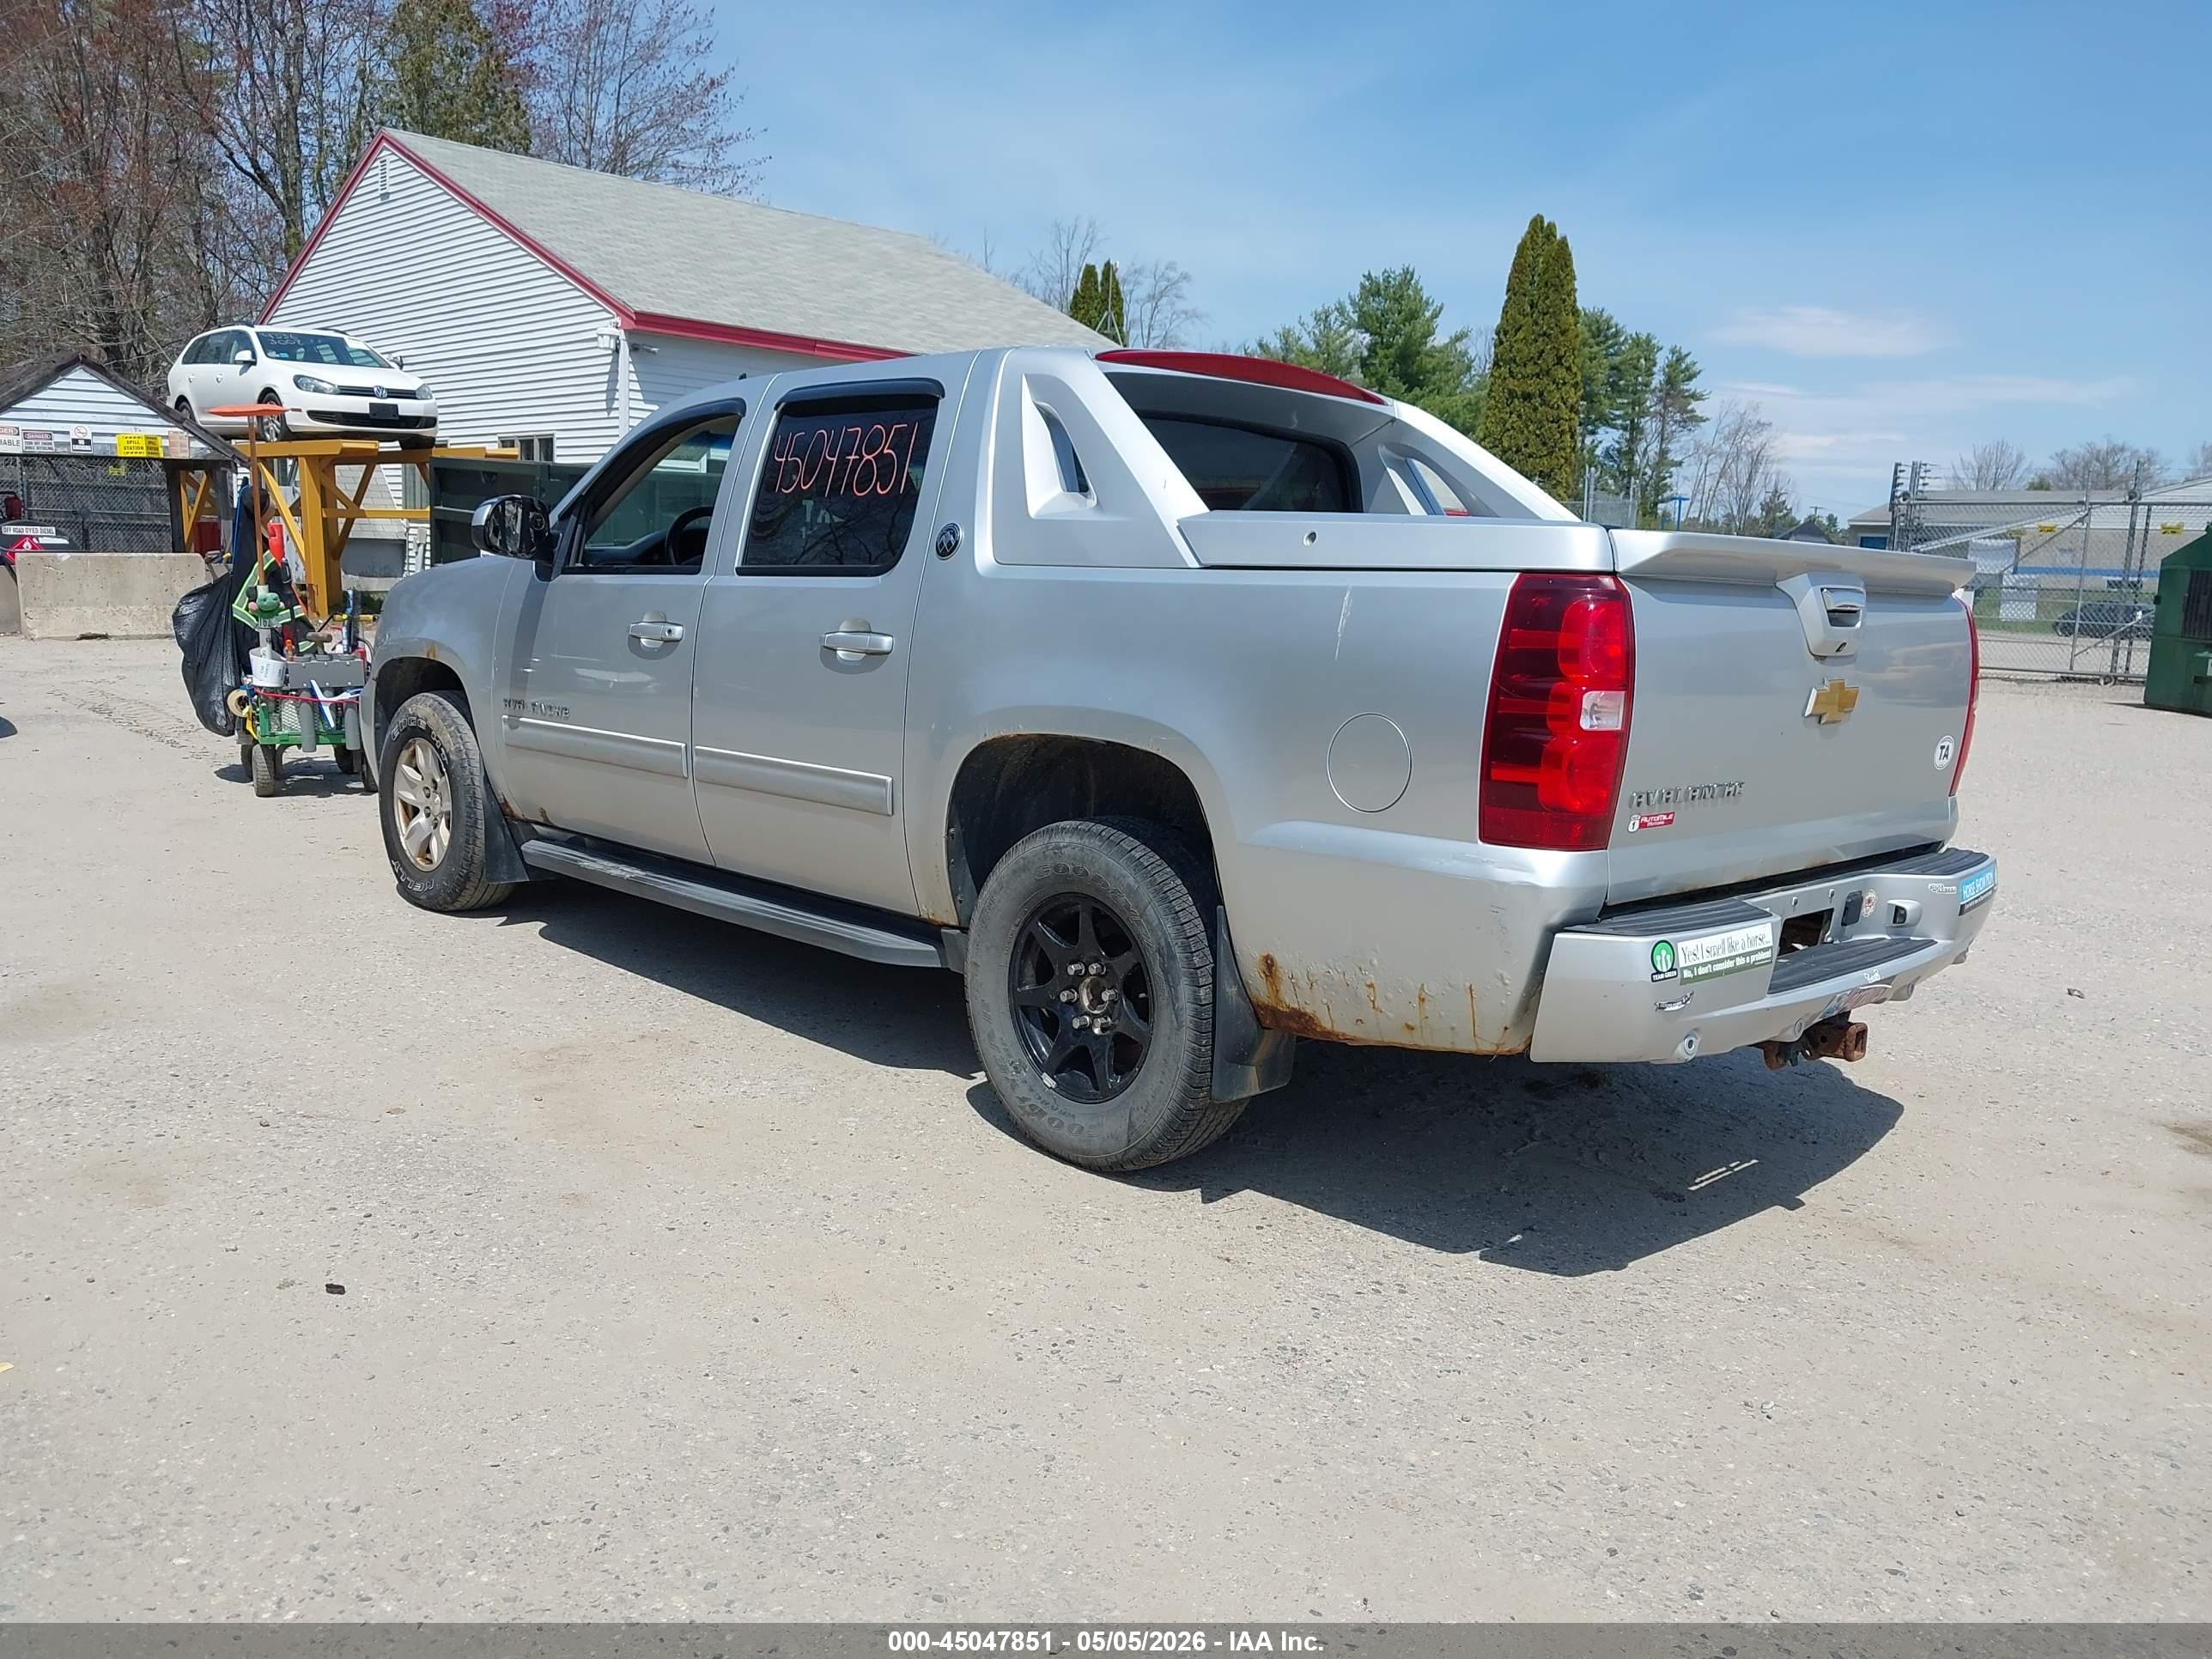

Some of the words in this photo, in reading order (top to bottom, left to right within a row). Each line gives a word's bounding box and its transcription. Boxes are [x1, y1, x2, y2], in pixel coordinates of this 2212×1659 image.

[774, 422, 919, 497] 45047851
[392, 715, 428, 742] EDGE
[1938, 744, 1950, 761] TA
[1681, 944, 1699, 963] Yes!
[1700, 942, 1705, 960] I
[1706, 939, 1726, 958] smell
[1727, 935, 1740, 953] like
[1741, 938, 1746, 951] a
[1652, 973, 1664, 981] TEAM
[1683, 969, 1693, 979] No,
[1694, 966, 1698, 976] I
[1698, 963, 1712, 975] don't
[1713, 959, 1735, 971] consider
[1736, 956, 1746, 966] this
